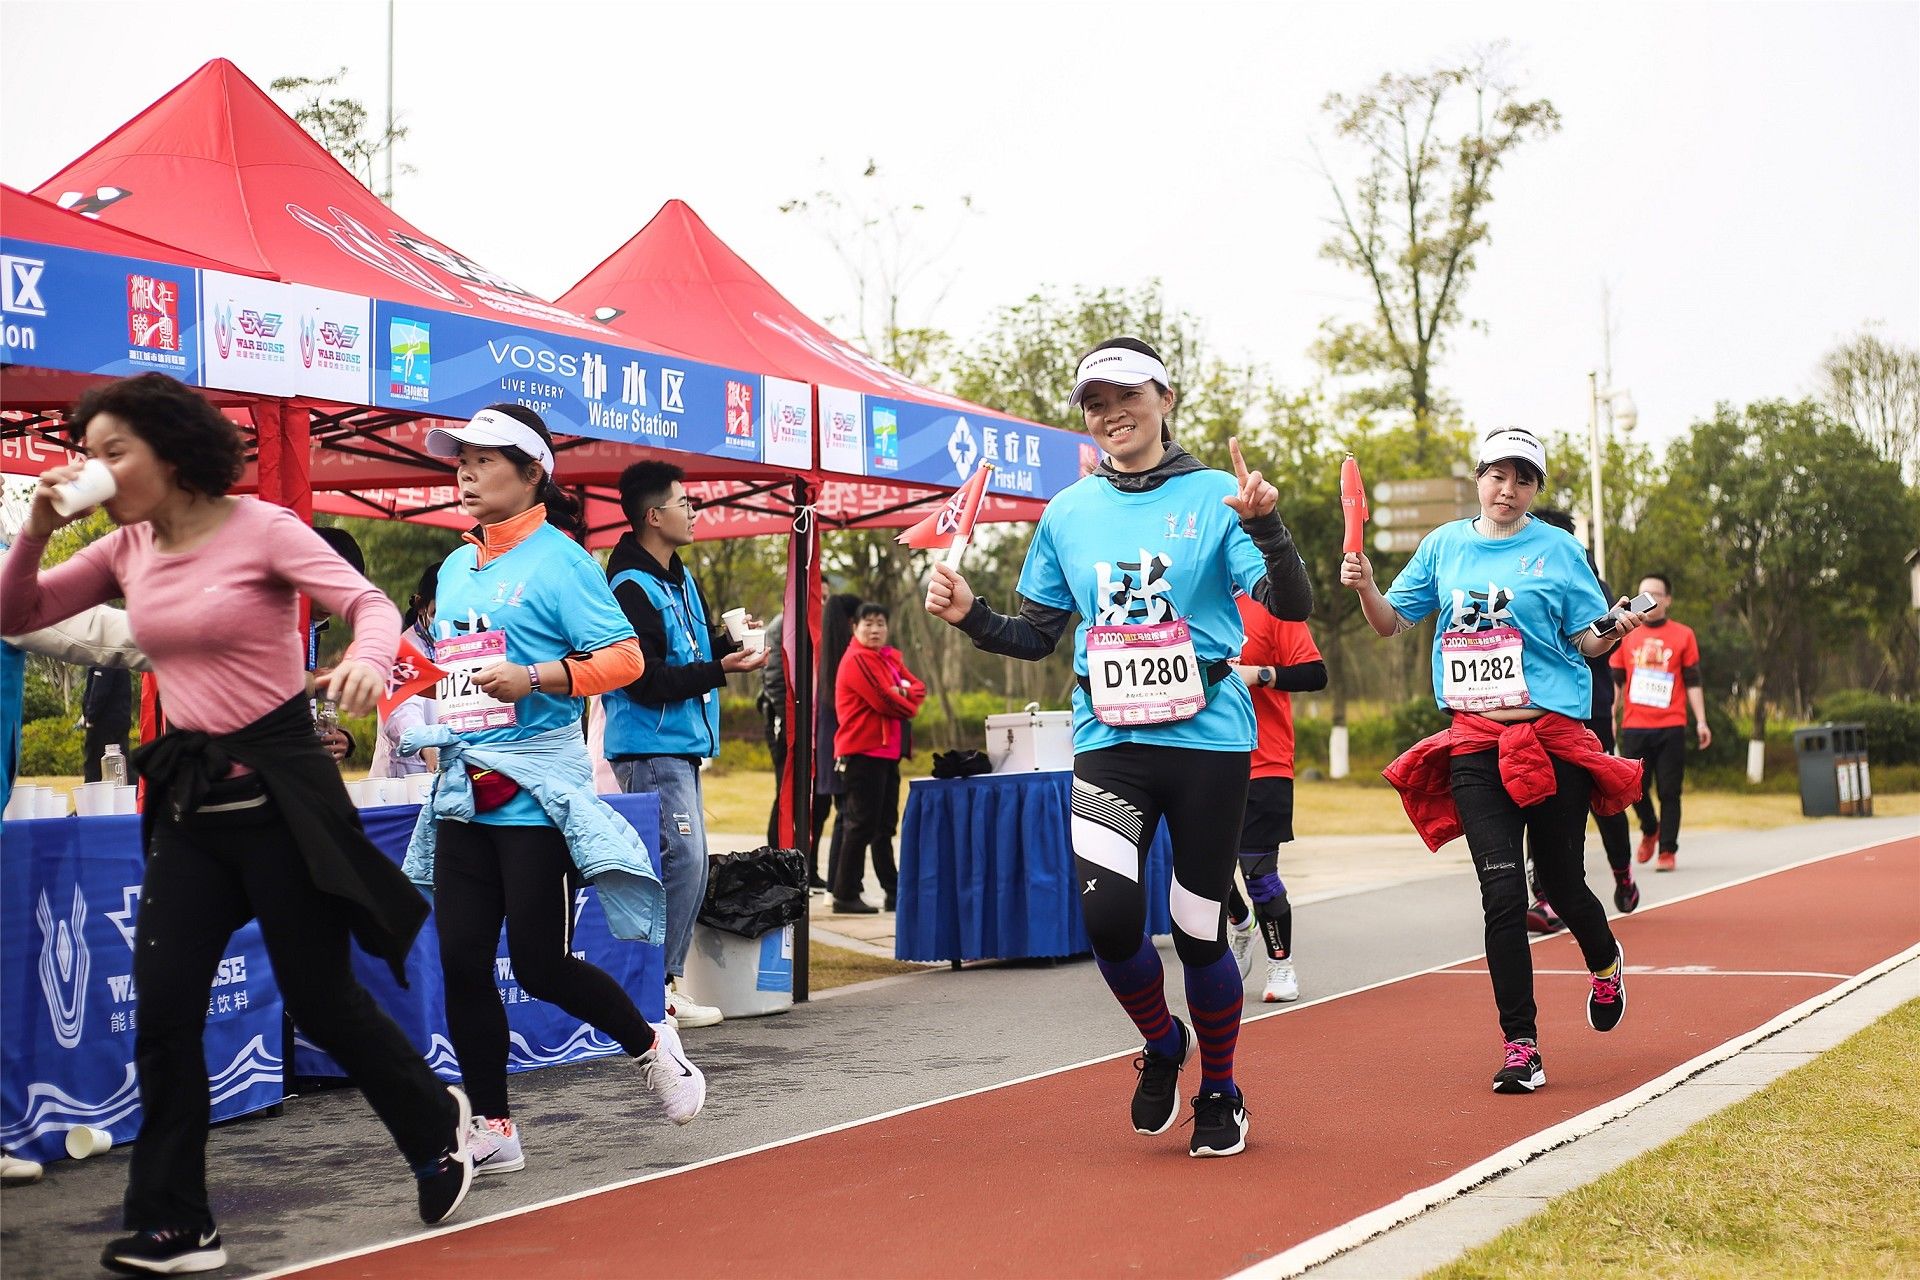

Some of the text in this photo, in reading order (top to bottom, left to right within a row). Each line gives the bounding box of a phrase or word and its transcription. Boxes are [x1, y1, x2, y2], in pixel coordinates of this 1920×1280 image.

[236, 338, 285, 353] WAR HORSE
[318, 348, 361, 364] WAR HORSE
[488, 340, 577, 377] VOSS
[502, 377, 564, 399] LIVE EVERY
[589, 402, 678, 438] Water Station
[983, 427, 1041, 467] 医疗区
[994, 467, 1033, 492] First Aid
[1104, 654, 1188, 689] D1280
[1451, 656, 1515, 683] D1282
